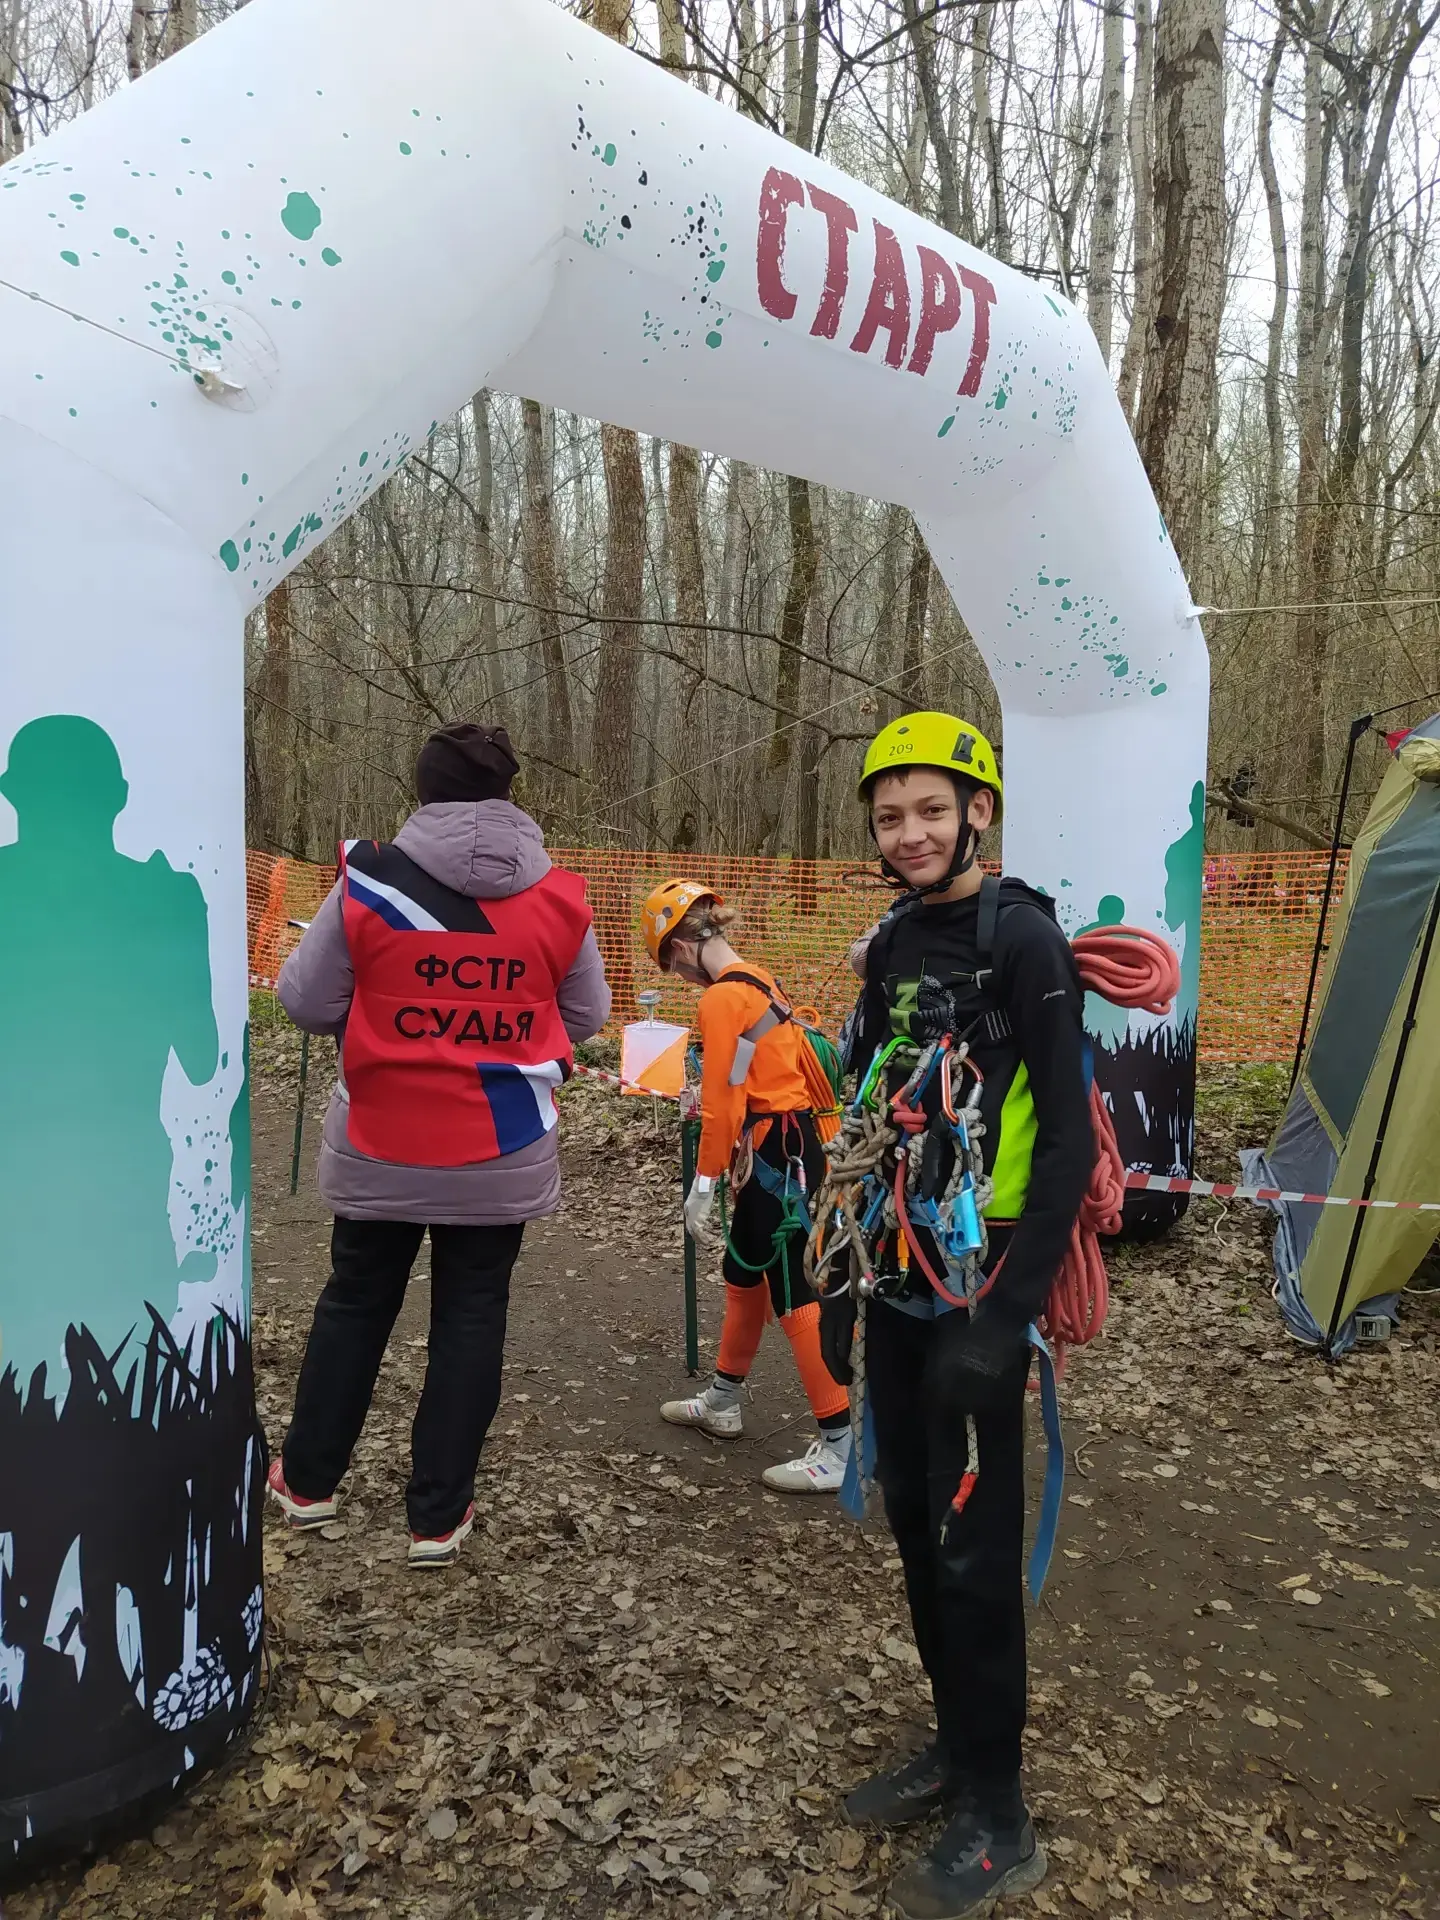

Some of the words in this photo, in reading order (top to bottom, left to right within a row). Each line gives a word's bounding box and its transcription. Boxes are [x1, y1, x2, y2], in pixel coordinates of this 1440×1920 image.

[757, 166, 997, 398] СТАРТ
[888, 743, 914, 757] 209
[414, 954, 526, 991] ФСТР
[394, 1006, 534, 1045] СУДЬЯ
